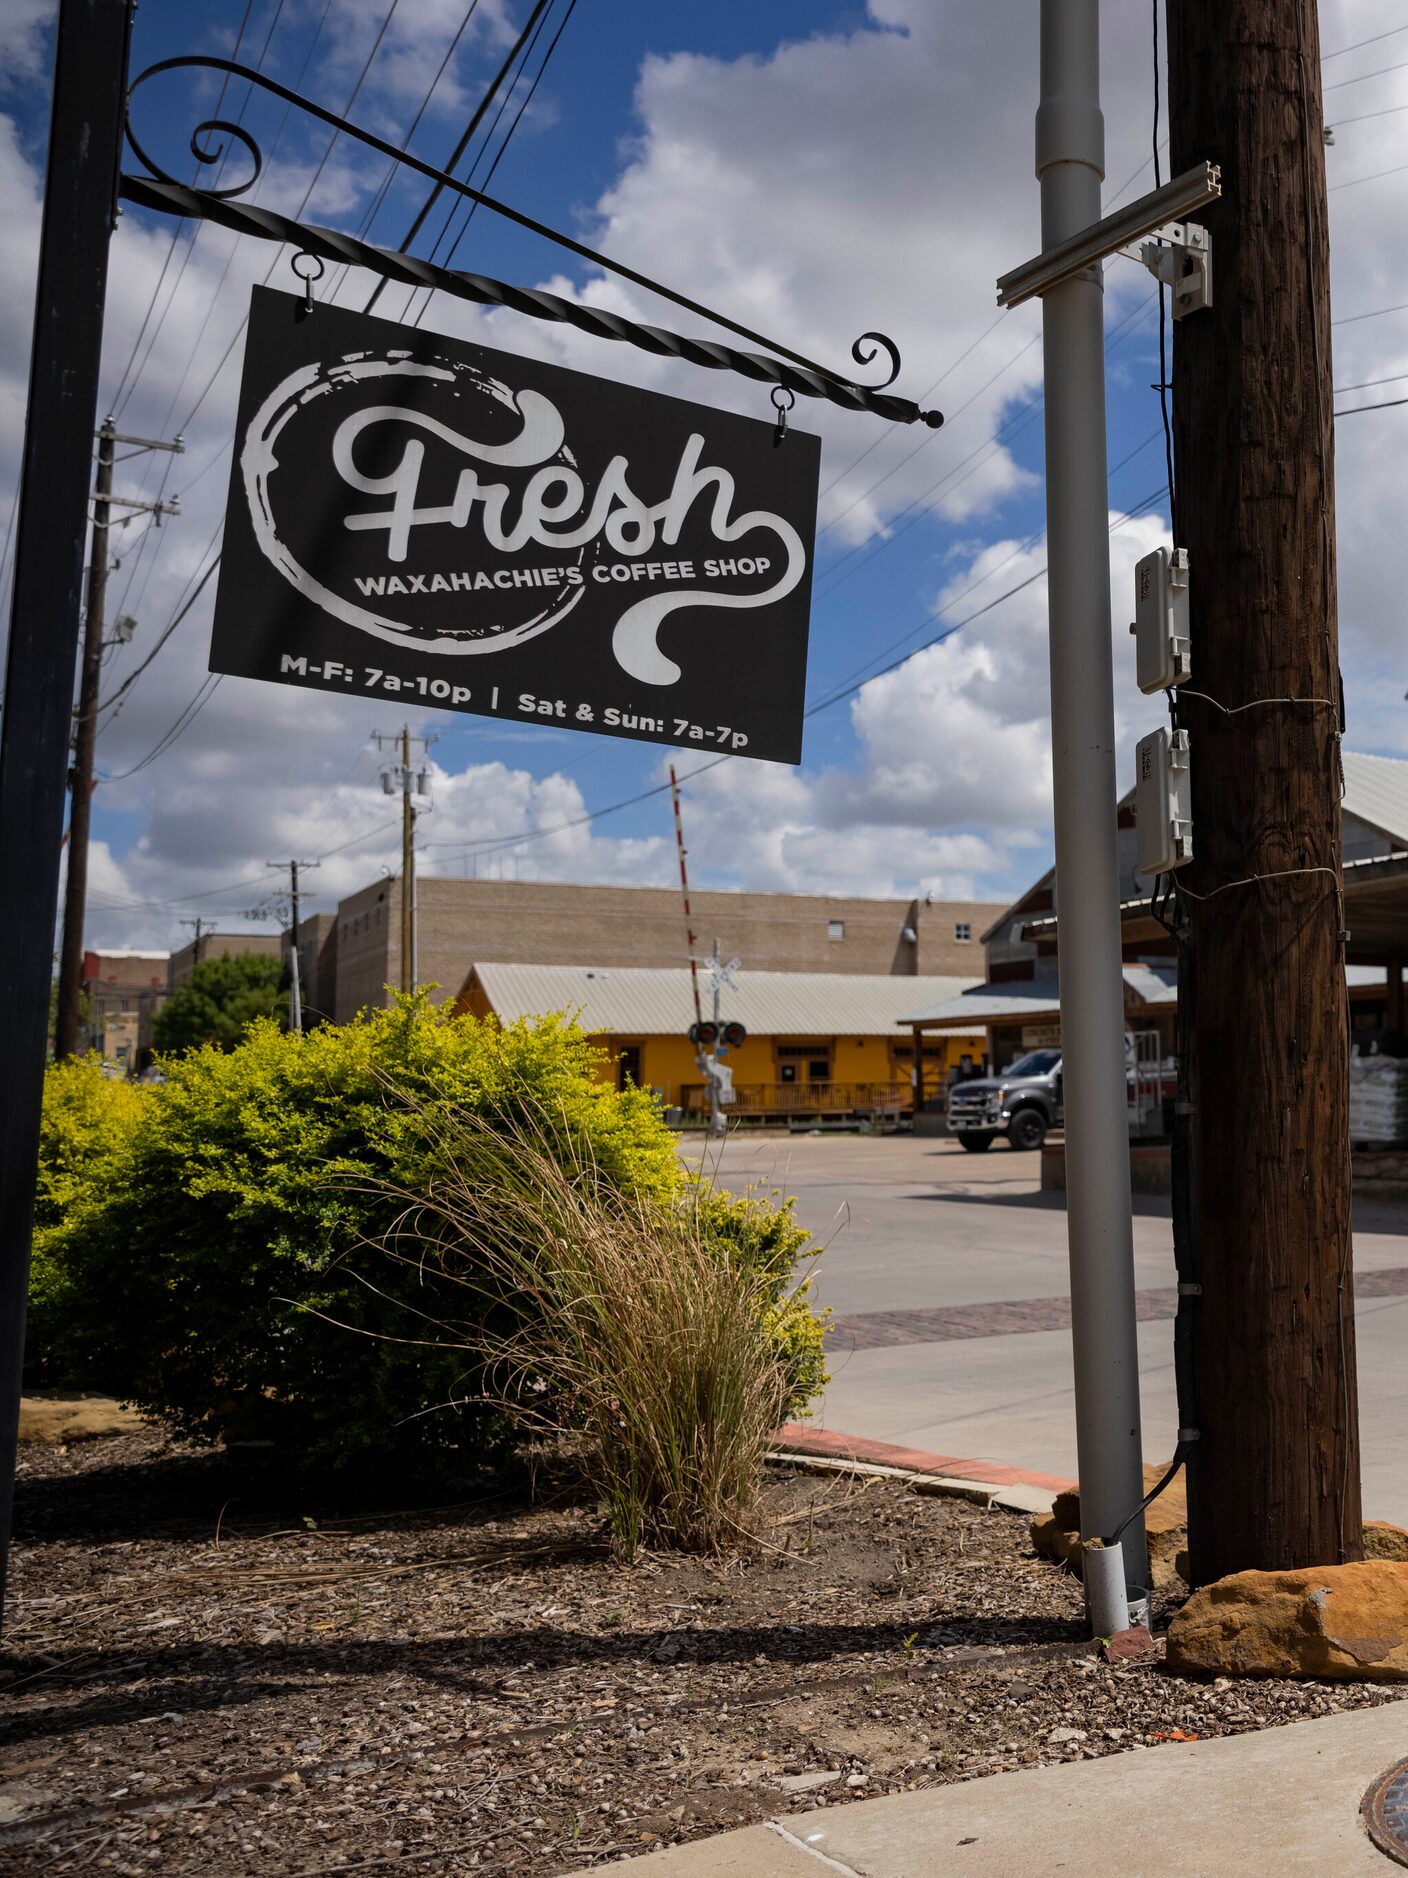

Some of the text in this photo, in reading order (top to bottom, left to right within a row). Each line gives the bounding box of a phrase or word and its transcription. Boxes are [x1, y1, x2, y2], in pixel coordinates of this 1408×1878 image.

[332, 389, 806, 563] Fresh
[354, 557, 771, 597] WAXAHACHIE'S COFFEE SHOP
[280, 653, 353, 682] M-F:
[364, 667, 472, 704] 7a-10p
[517, 693, 567, 718] Sat
[575, 703, 595, 722] &
[603, 707, 664, 732] Sun:
[672, 718, 749, 749] 7a-7p
